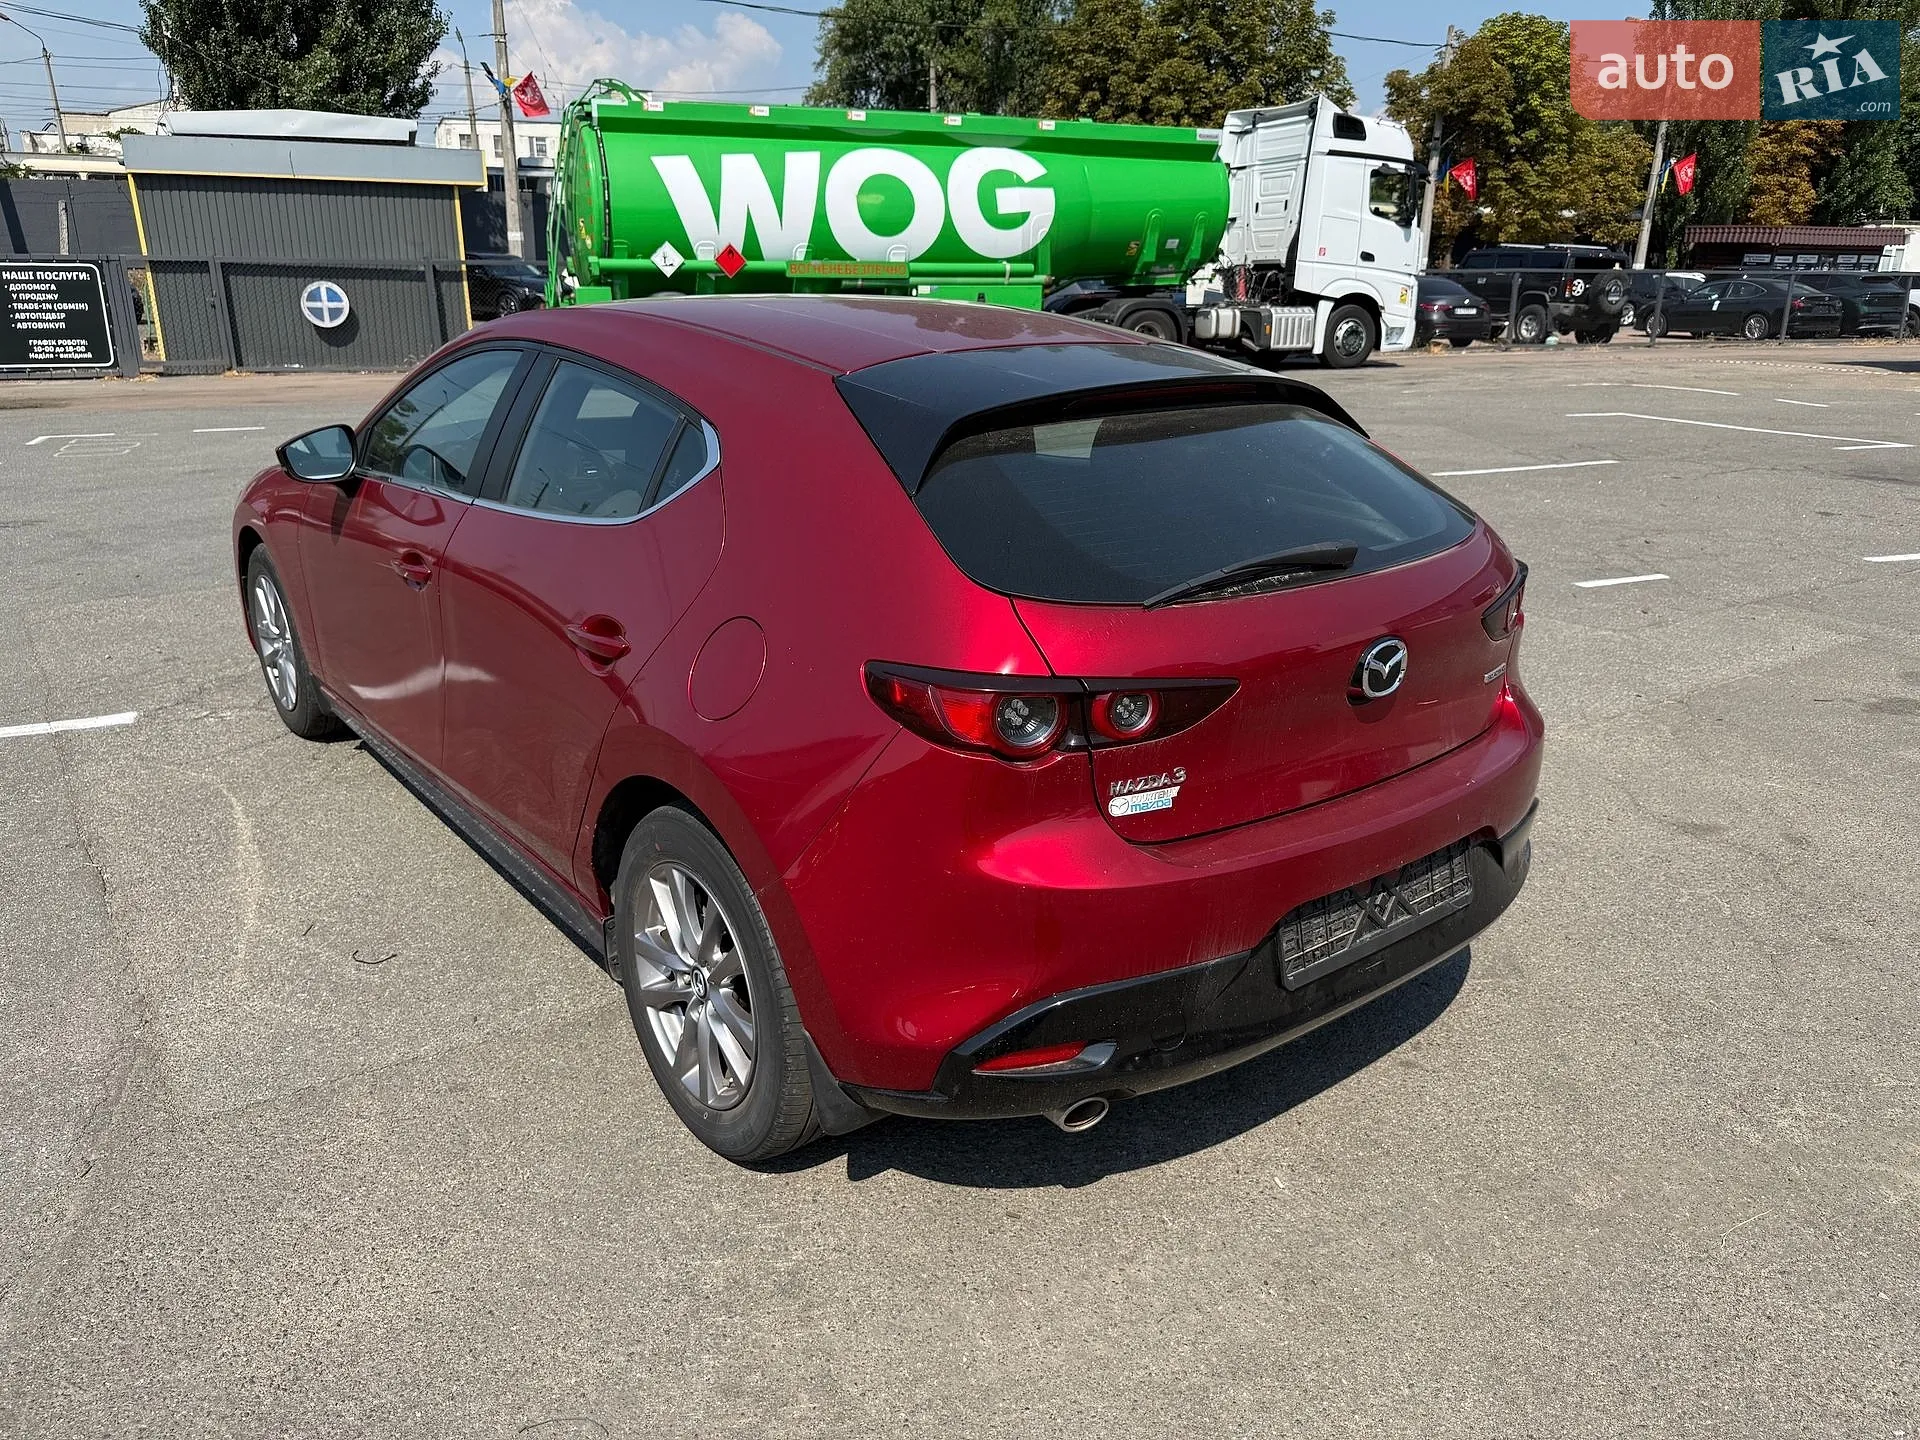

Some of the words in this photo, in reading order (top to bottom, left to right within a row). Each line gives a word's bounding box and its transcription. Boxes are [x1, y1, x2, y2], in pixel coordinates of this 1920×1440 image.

[650, 147, 1056, 262] WOG
[2, 271, 35, 280] НАШІ
[36, 272, 90, 280] ПОСЛУГИ:
[12, 302, 52, 310] TRADE-IN
[53, 302, 89, 311] (ОБМІН)
[15, 312, 66, 320] АВТОПІДБІР
[1130, 797, 1171, 813] mazda
